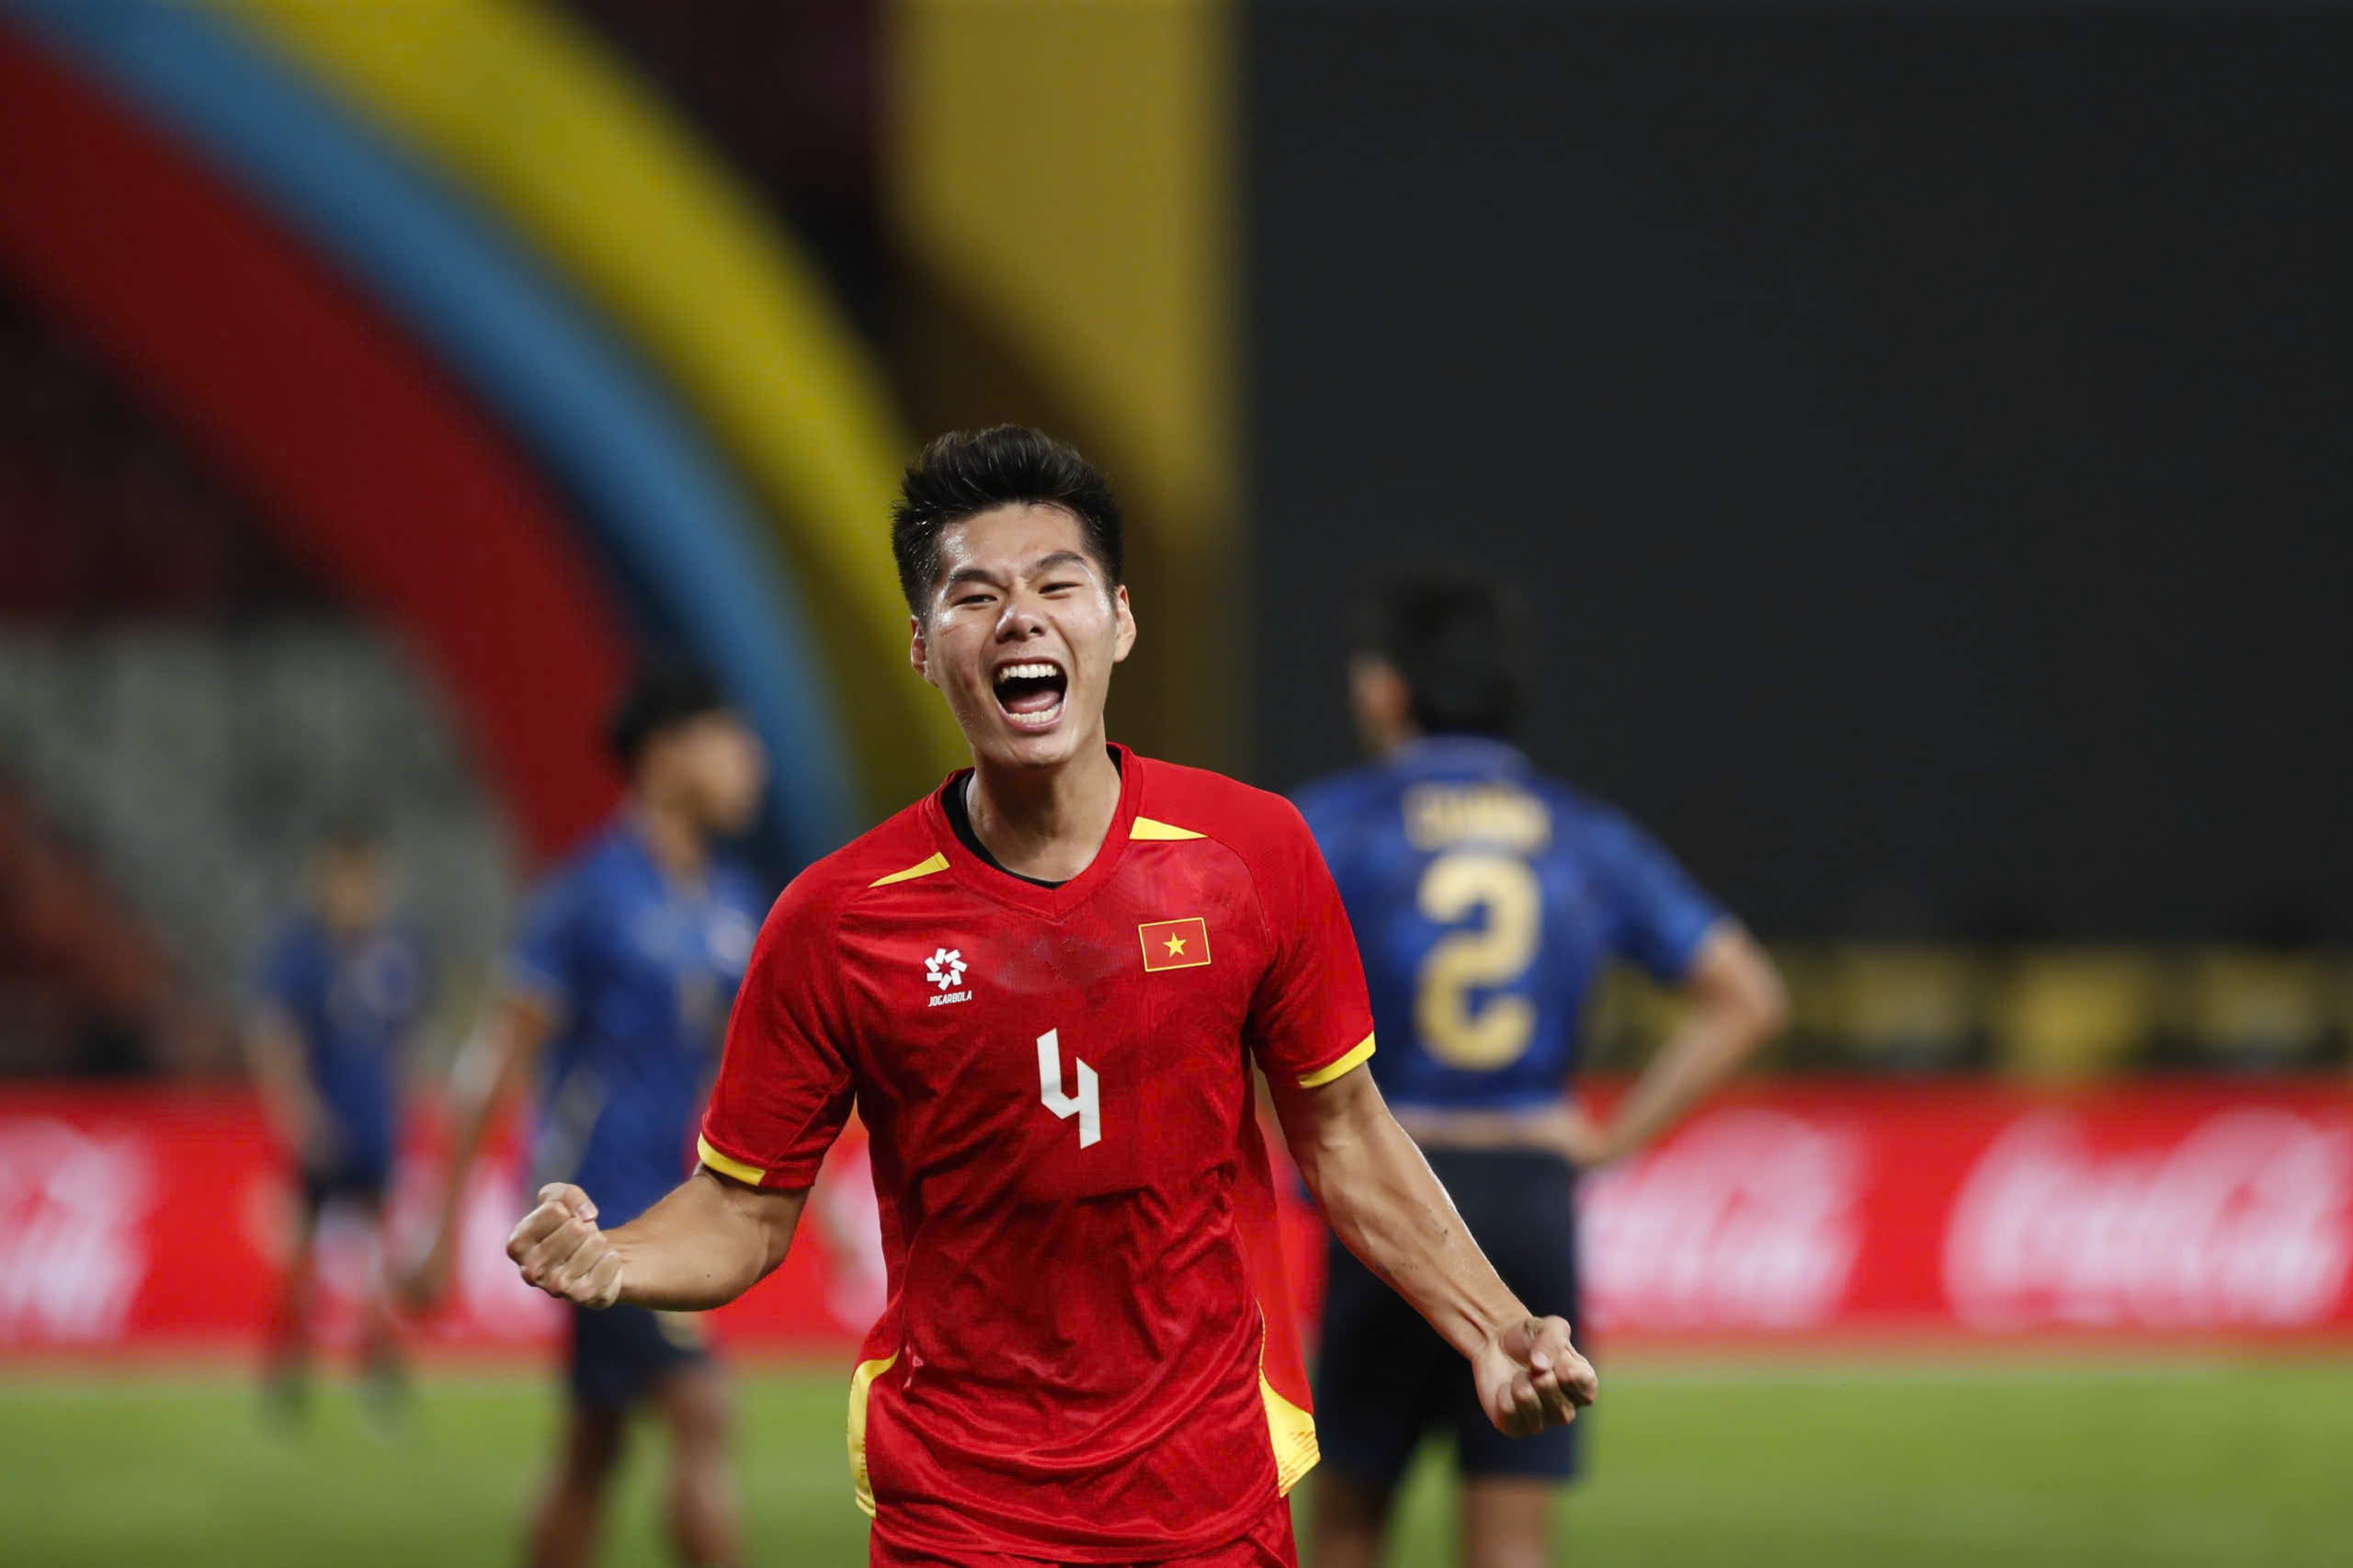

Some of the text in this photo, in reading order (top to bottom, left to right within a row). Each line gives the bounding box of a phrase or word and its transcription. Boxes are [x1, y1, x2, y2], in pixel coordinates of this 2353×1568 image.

[927, 990, 972, 1007] JOGARBOLA
[1416, 853, 1542, 1072] 2
[1036, 1028, 1102, 1150] 4
